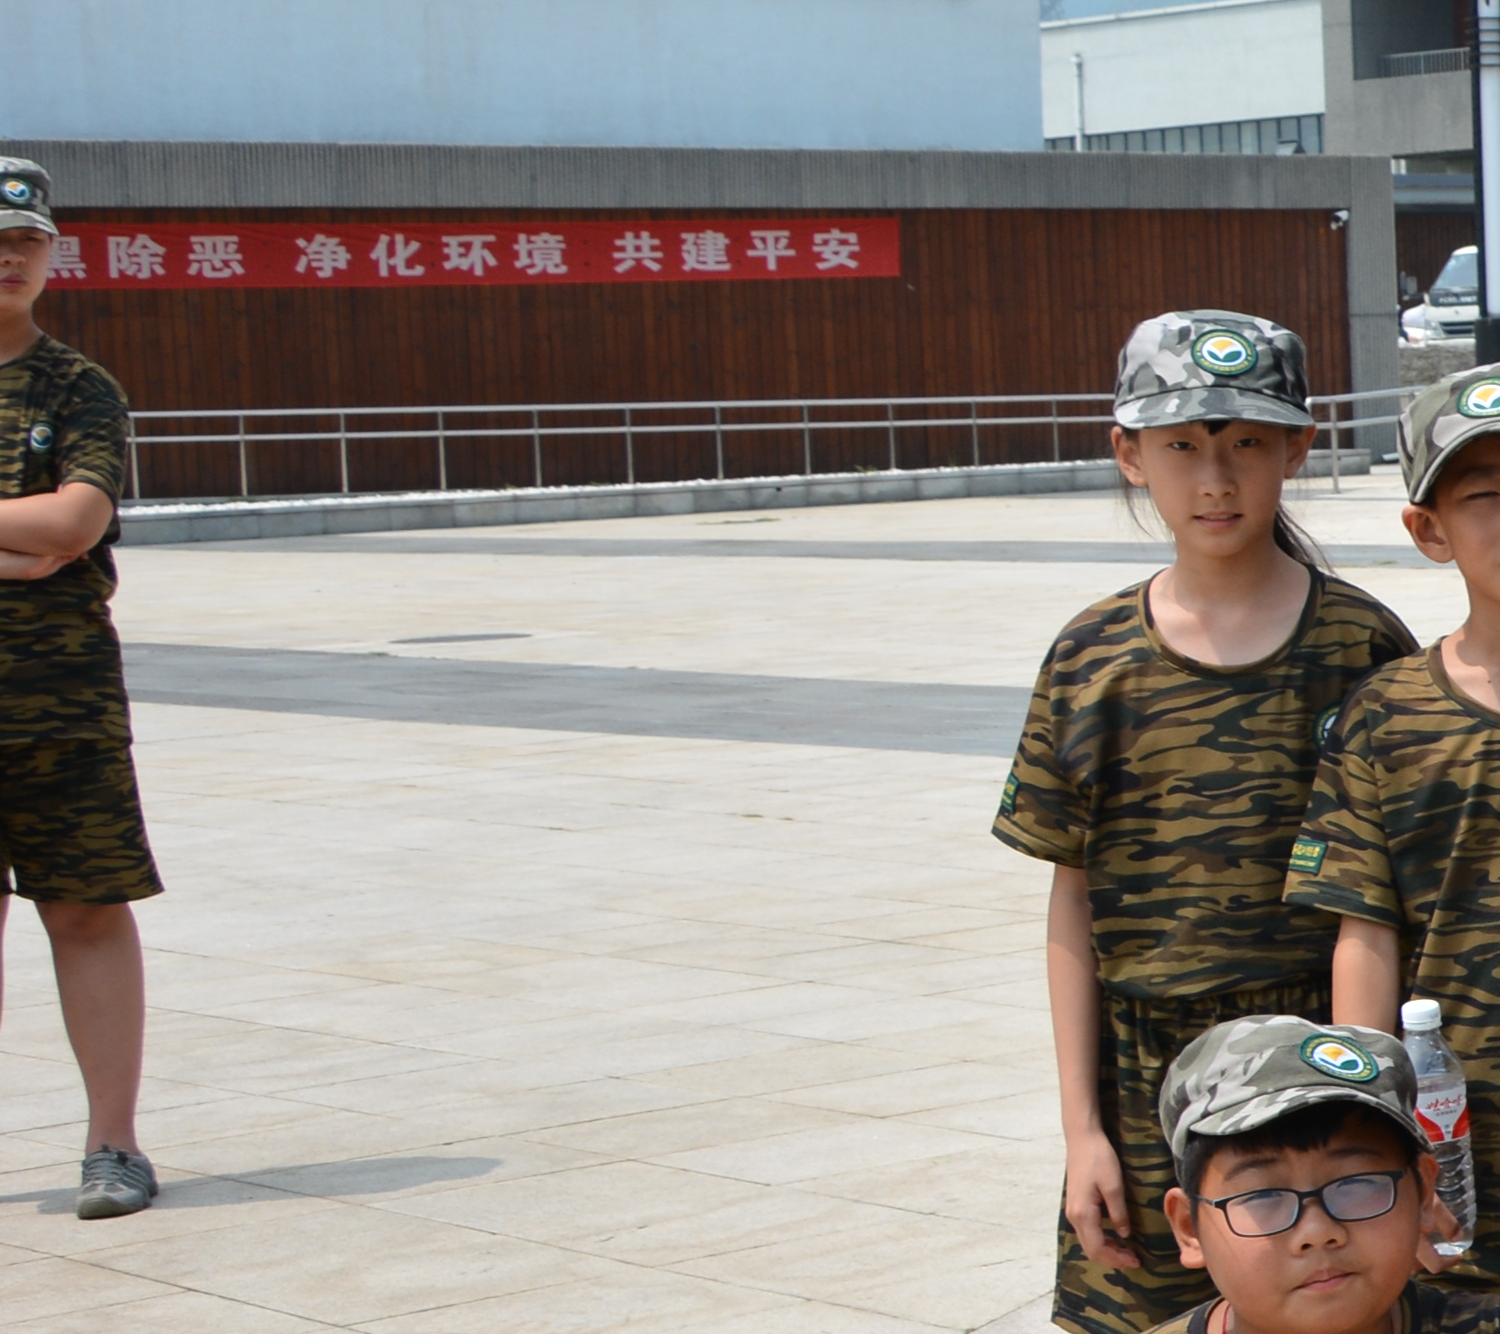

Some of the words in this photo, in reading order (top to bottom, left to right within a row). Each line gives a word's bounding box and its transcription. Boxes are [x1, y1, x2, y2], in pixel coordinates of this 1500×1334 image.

[294, 231, 569, 279] 净化环境
[611, 227, 862, 273] 共建平安
